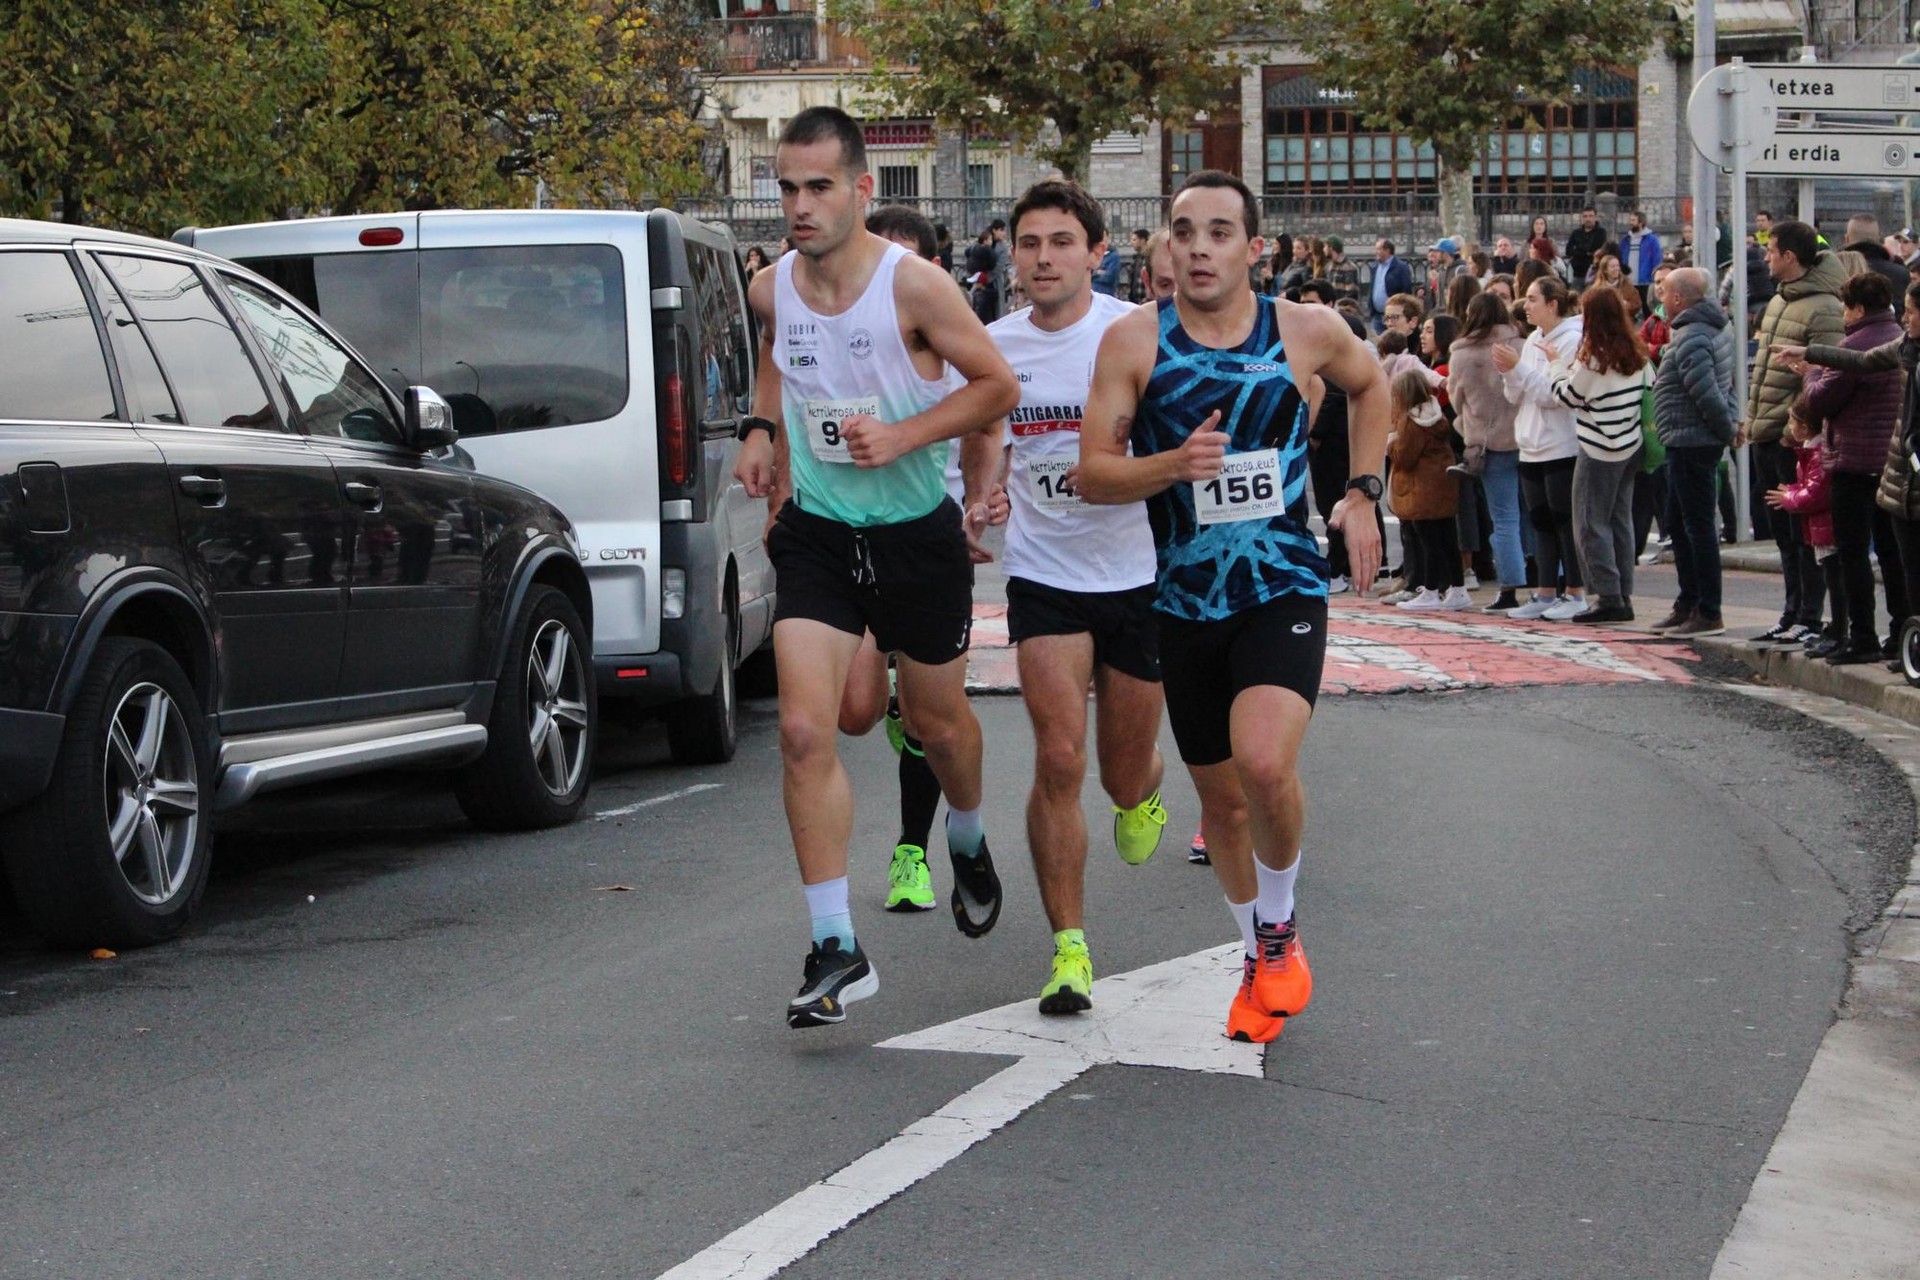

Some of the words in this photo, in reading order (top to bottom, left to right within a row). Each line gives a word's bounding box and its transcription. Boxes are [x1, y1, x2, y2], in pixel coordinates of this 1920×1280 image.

[1789, 145, 1840, 161] erdia
[1009, 405, 1086, 422] ASTIGARRA
[1203, 473, 1273, 505] 156
